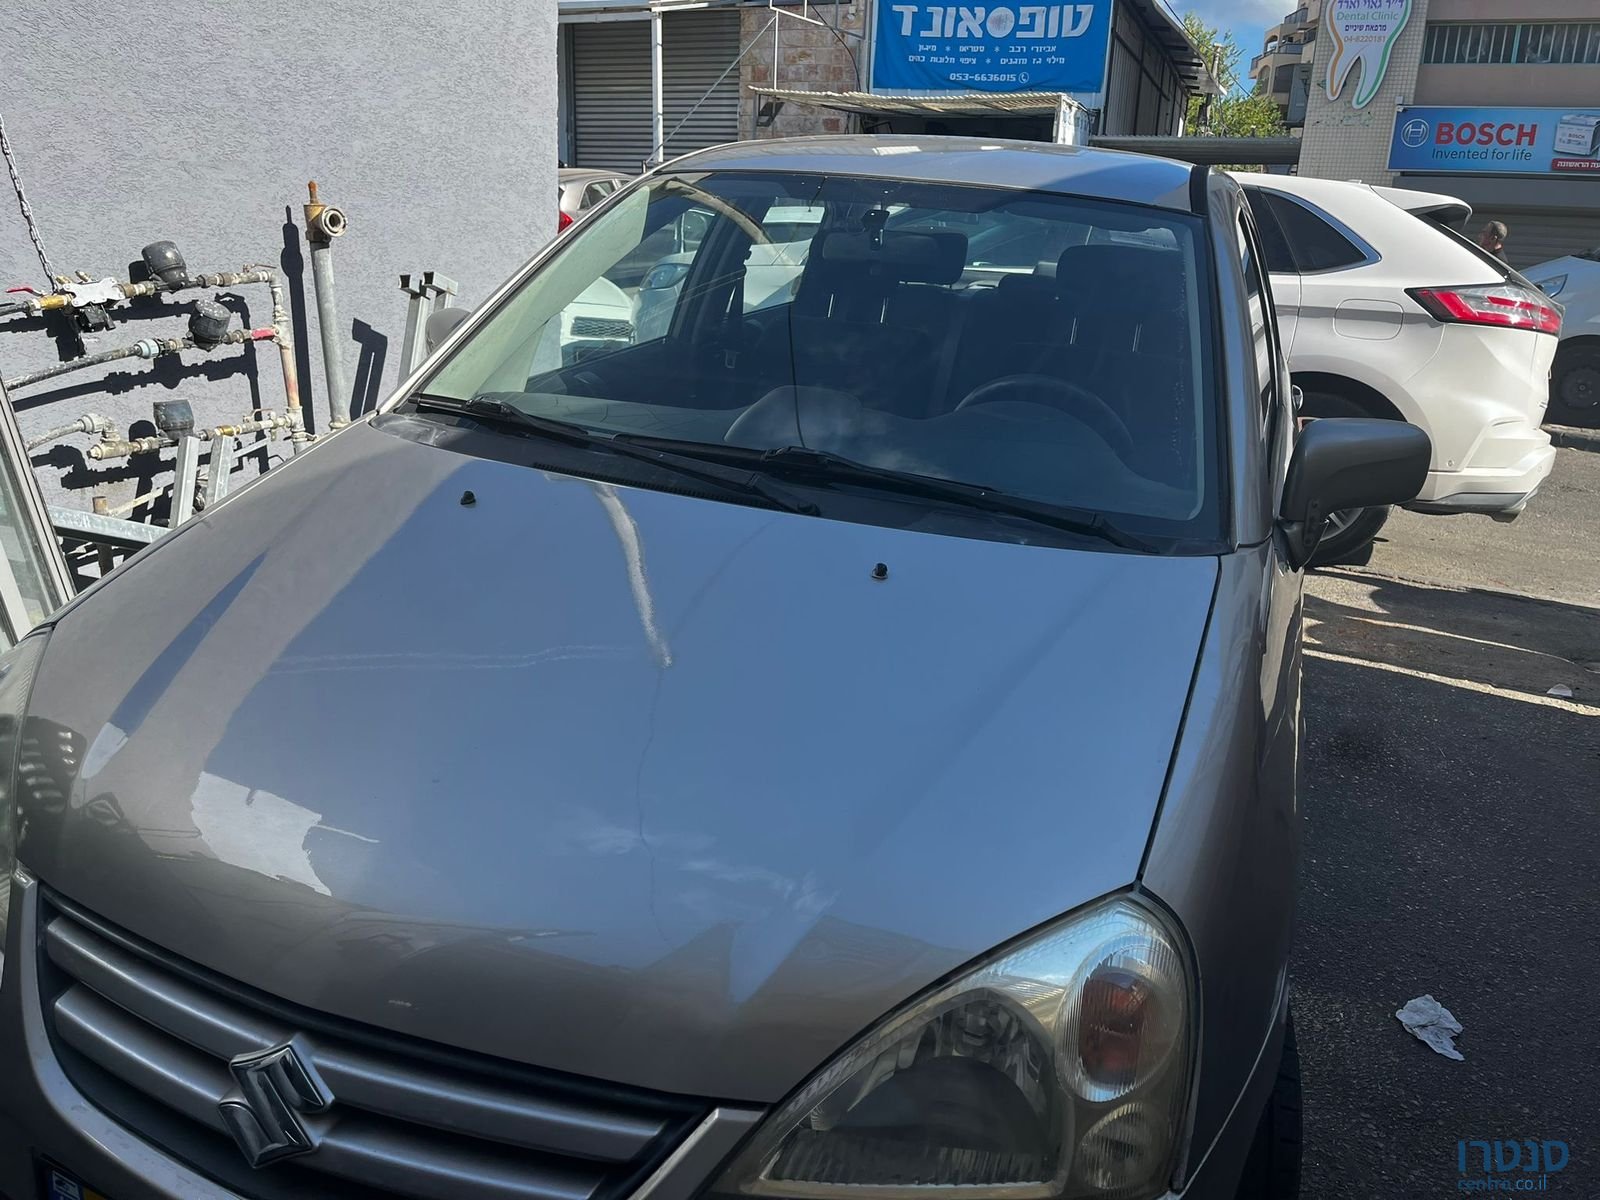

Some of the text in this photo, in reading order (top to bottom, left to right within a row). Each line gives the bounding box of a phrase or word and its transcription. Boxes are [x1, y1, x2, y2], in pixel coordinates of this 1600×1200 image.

[1337, 11, 1398, 21] Dental Clinic
[918, 43, 1057, 53] אביזרי רכב סטריאו מיגון
[929, 56, 955, 64] חלונות
[959, 57, 977, 65] ציפוי
[1000, 57, 1028, 65] מזגנים
[1032, 57, 1042, 65] גז
[1046, 56, 1065, 65] מילוי
[949, 72, 1017, 82] 053-6636015
[1435, 122, 1538, 146] BOSCH
[1432, 147, 1532, 161] Invented for life
[1557, 160, 1590, 168] הראשונה
